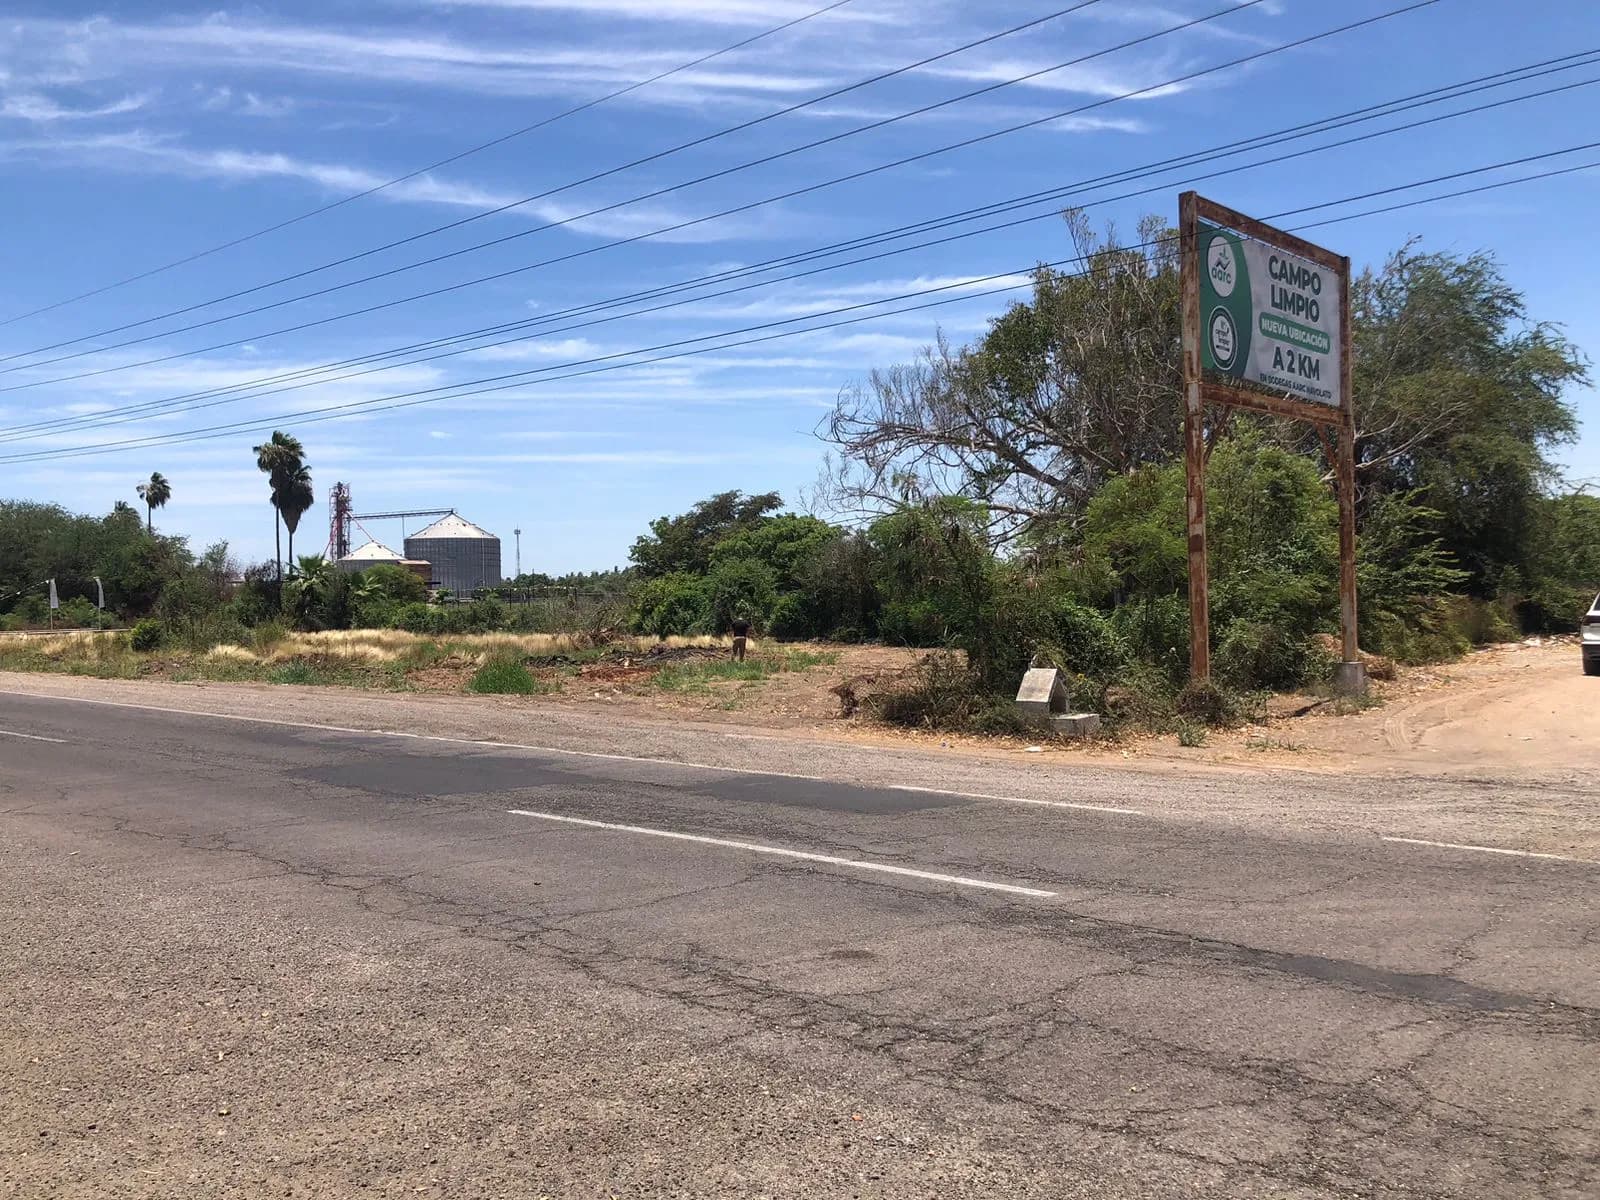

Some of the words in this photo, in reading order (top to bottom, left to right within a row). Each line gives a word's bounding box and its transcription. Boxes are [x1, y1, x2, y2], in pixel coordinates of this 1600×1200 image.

[1268, 255, 1321, 296] CAMPO
[1271, 284, 1320, 323] LIMPIO
[1261, 318, 1288, 337] NUEVA
[1272, 346, 1285, 372] A
[1286, 349, 1297, 374] 2
[1299, 353, 1320, 381] KM
